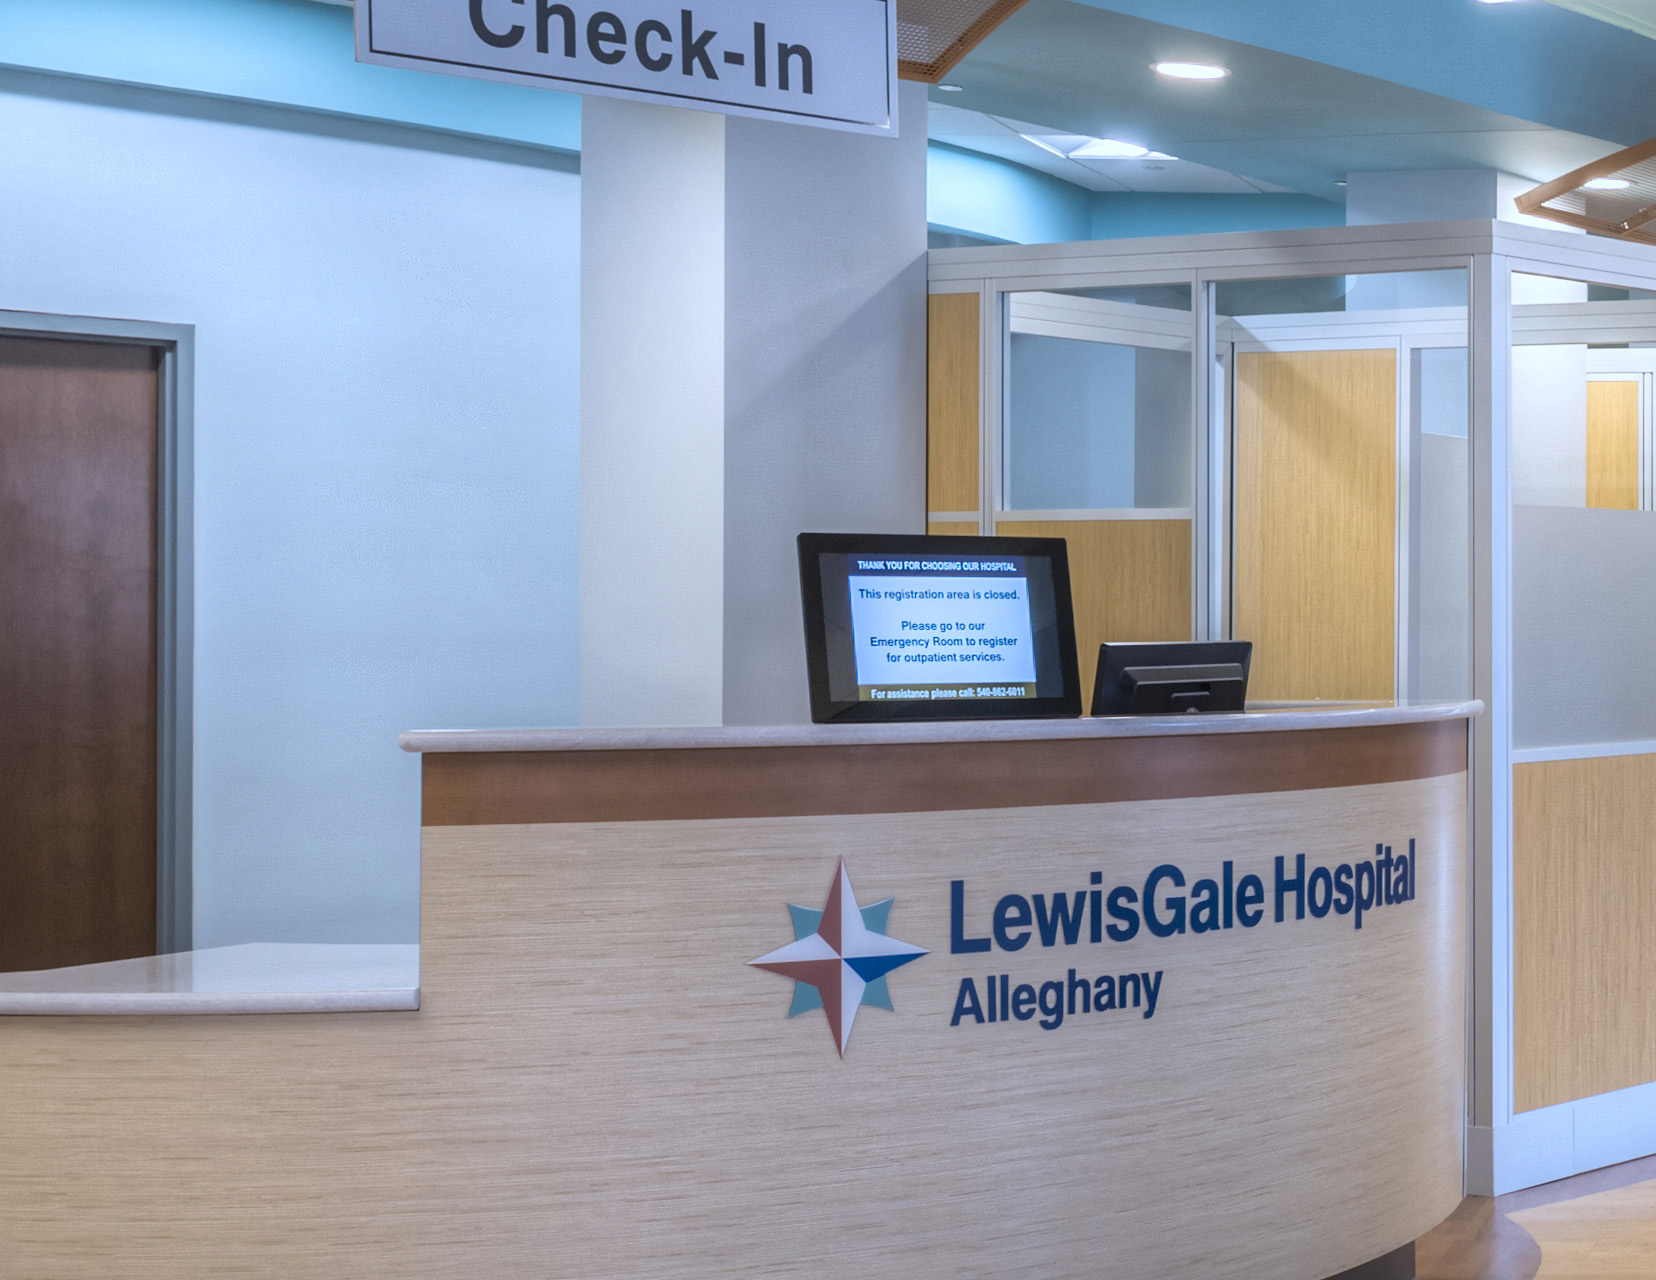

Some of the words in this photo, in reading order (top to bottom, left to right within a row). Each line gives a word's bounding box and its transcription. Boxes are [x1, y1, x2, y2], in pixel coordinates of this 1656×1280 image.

[857, 560, 885, 570] THANK
[886, 560, 903, 570] YOU
[904, 561, 921, 570] FOR
[921, 561, 961, 571] CHOOSING
[962, 562, 980, 571] OUR
[980, 562, 1017, 572] HOSPITAL
[858, 589, 881, 599] This
[884, 589, 943, 601] registration
[946, 592, 970, 600] area
[972, 590, 982, 600] is
[984, 590, 1020, 600] closed.
[901, 621, 937, 631] Please
[940, 623, 952, 632] go
[955, 622, 966, 630] to
[870, 636, 930, 649] Emergency
[933, 637, 963, 646] Room
[966, 637, 976, 646] to
[978, 637, 1018, 648] register
[886, 653, 901, 663] for
[904, 653, 957, 664] outpatient
[959, 652, 1005, 662] services.
[870, 688, 886, 699] For
[887, 688, 930, 699] assistance
[931, 688, 957, 701] please
[949, 861, 1265, 955] LewisGale
[1273, 838, 1416, 930] Hospital
[949, 969, 1164, 1030] Alleghany
